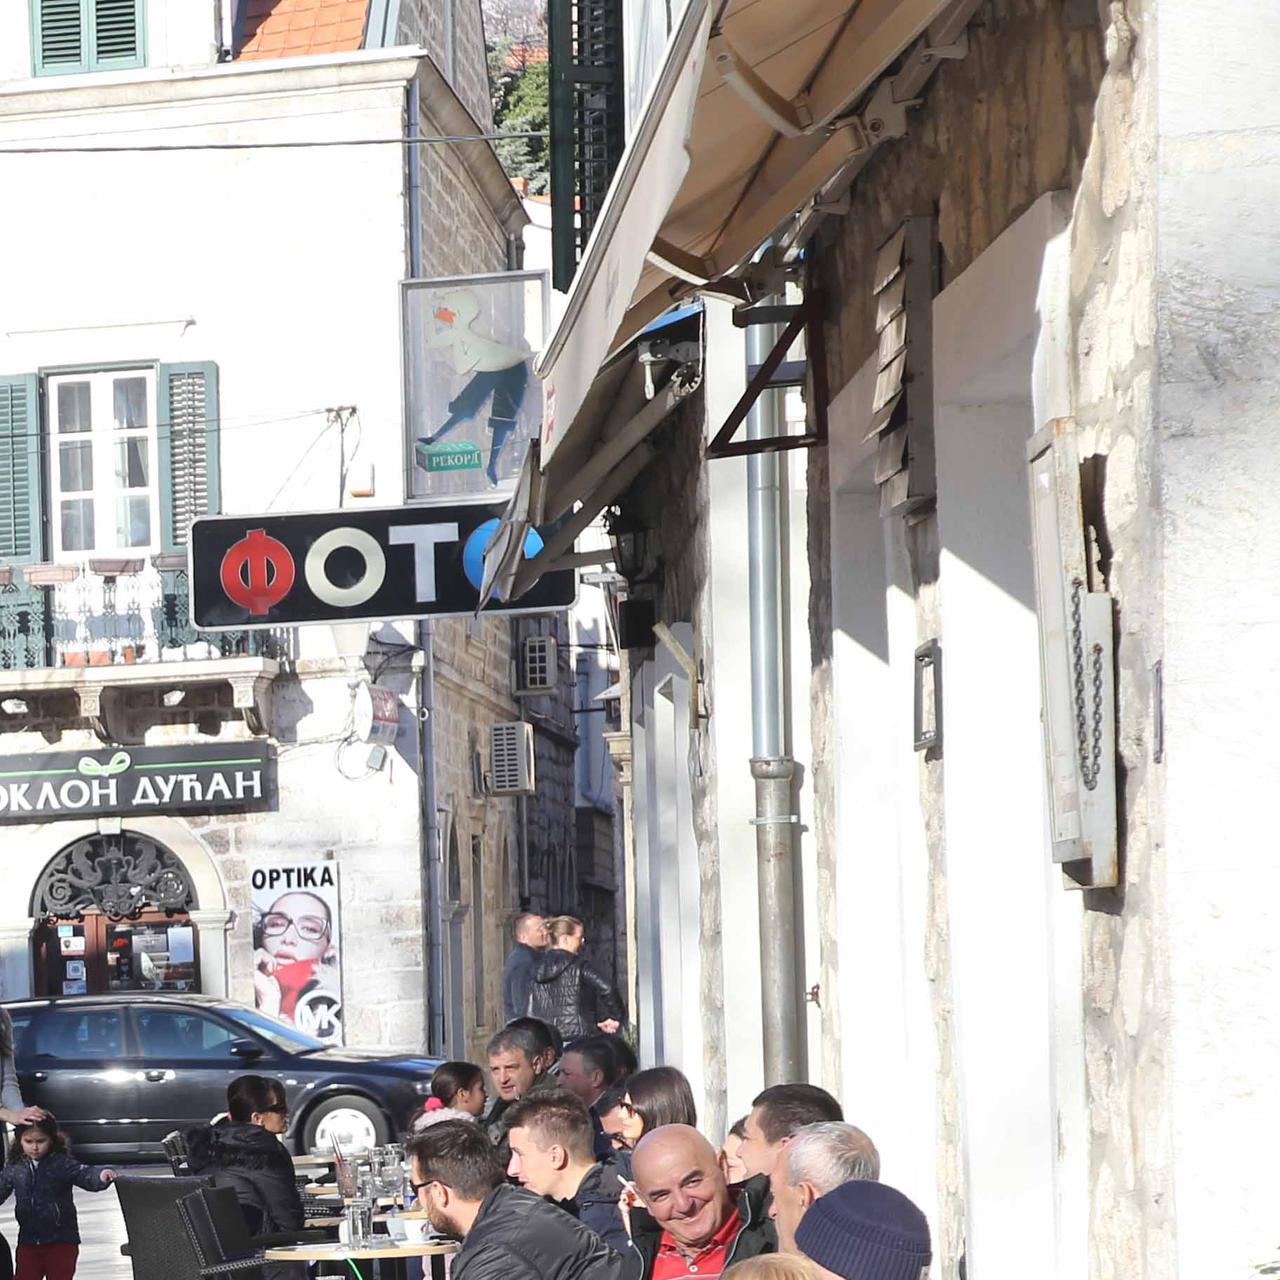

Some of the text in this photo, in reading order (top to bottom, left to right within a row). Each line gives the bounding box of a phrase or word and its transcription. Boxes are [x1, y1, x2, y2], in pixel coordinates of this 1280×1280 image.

[132, 770, 263, 806] ДУЋАН
[251, 866, 335, 890] OPTIKA
[300, 1002, 341, 1031] MK
